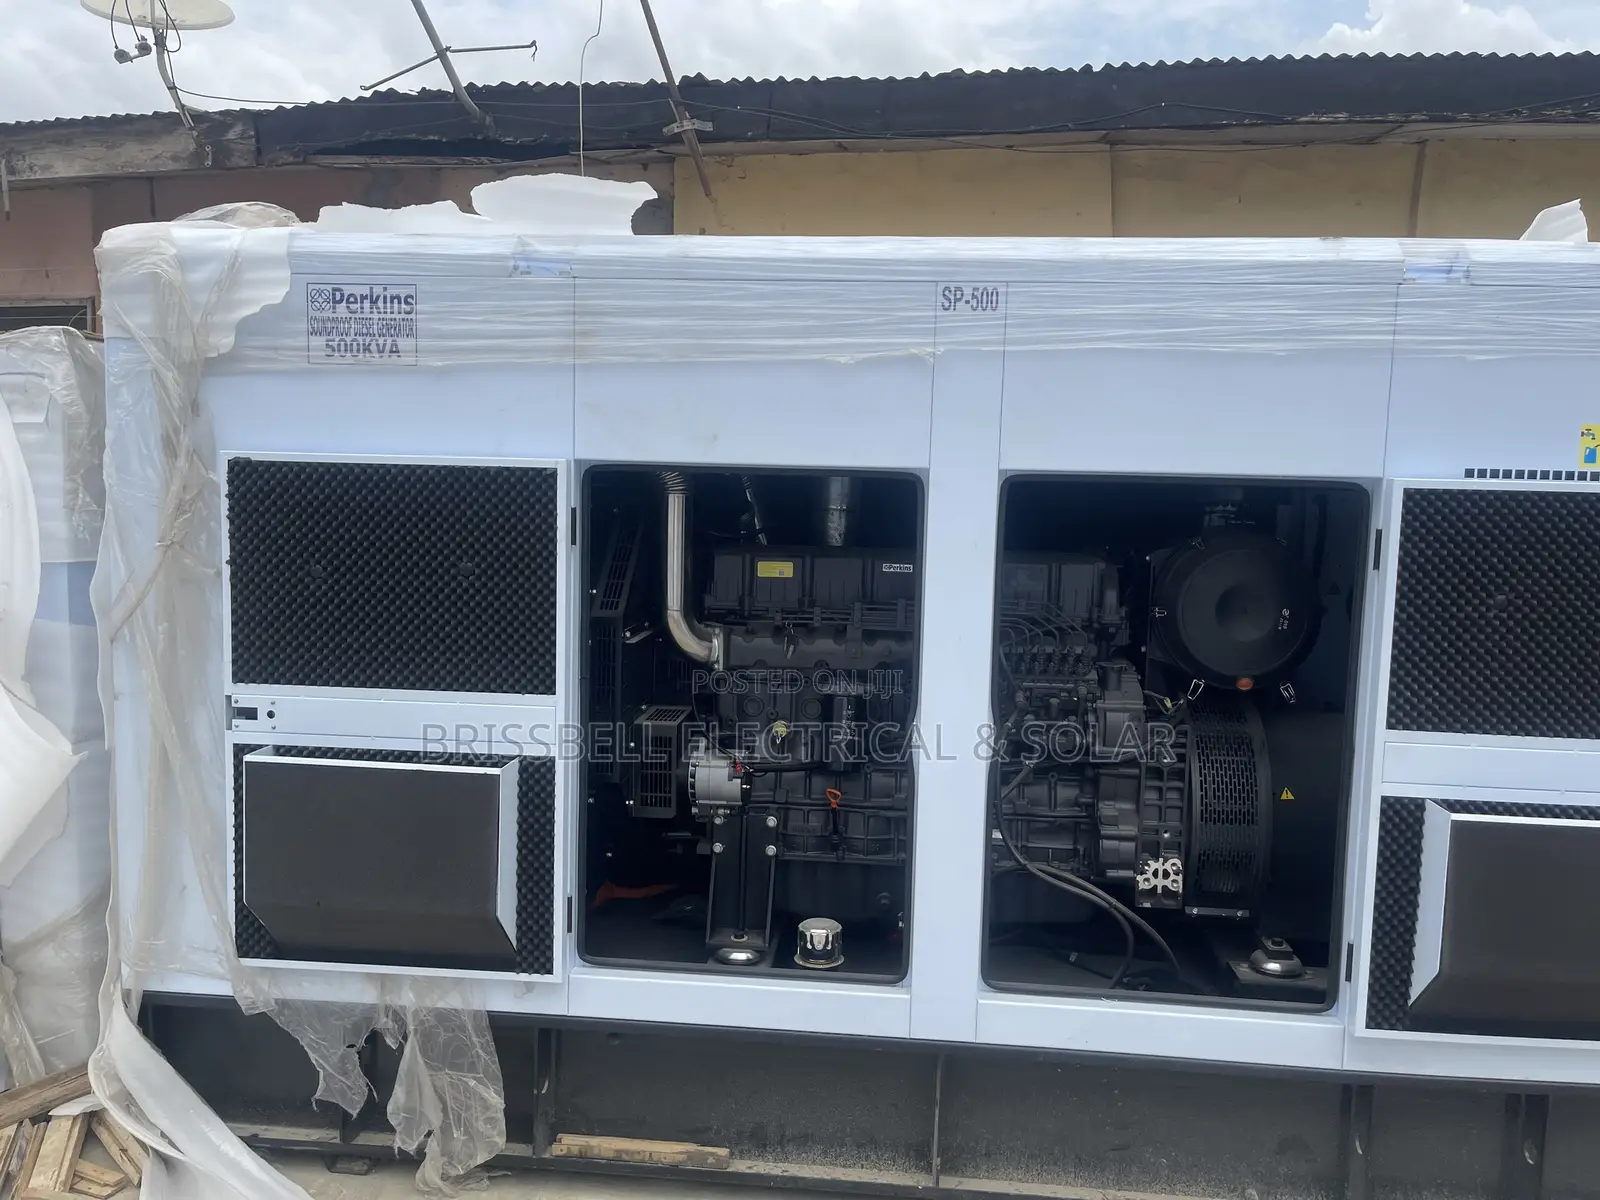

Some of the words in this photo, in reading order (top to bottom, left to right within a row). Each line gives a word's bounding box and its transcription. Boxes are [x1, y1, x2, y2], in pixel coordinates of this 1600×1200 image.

[331, 286, 415, 315] Perkins
[941, 286, 999, 311] SP-500
[309, 315, 353, 337] SOUNDPROOF
[353, 316, 376, 338] DIESEL
[377, 317, 415, 339] GENERATOR
[324, 338, 402, 358] 500KVA
[888, 564, 912, 572] Perkins
